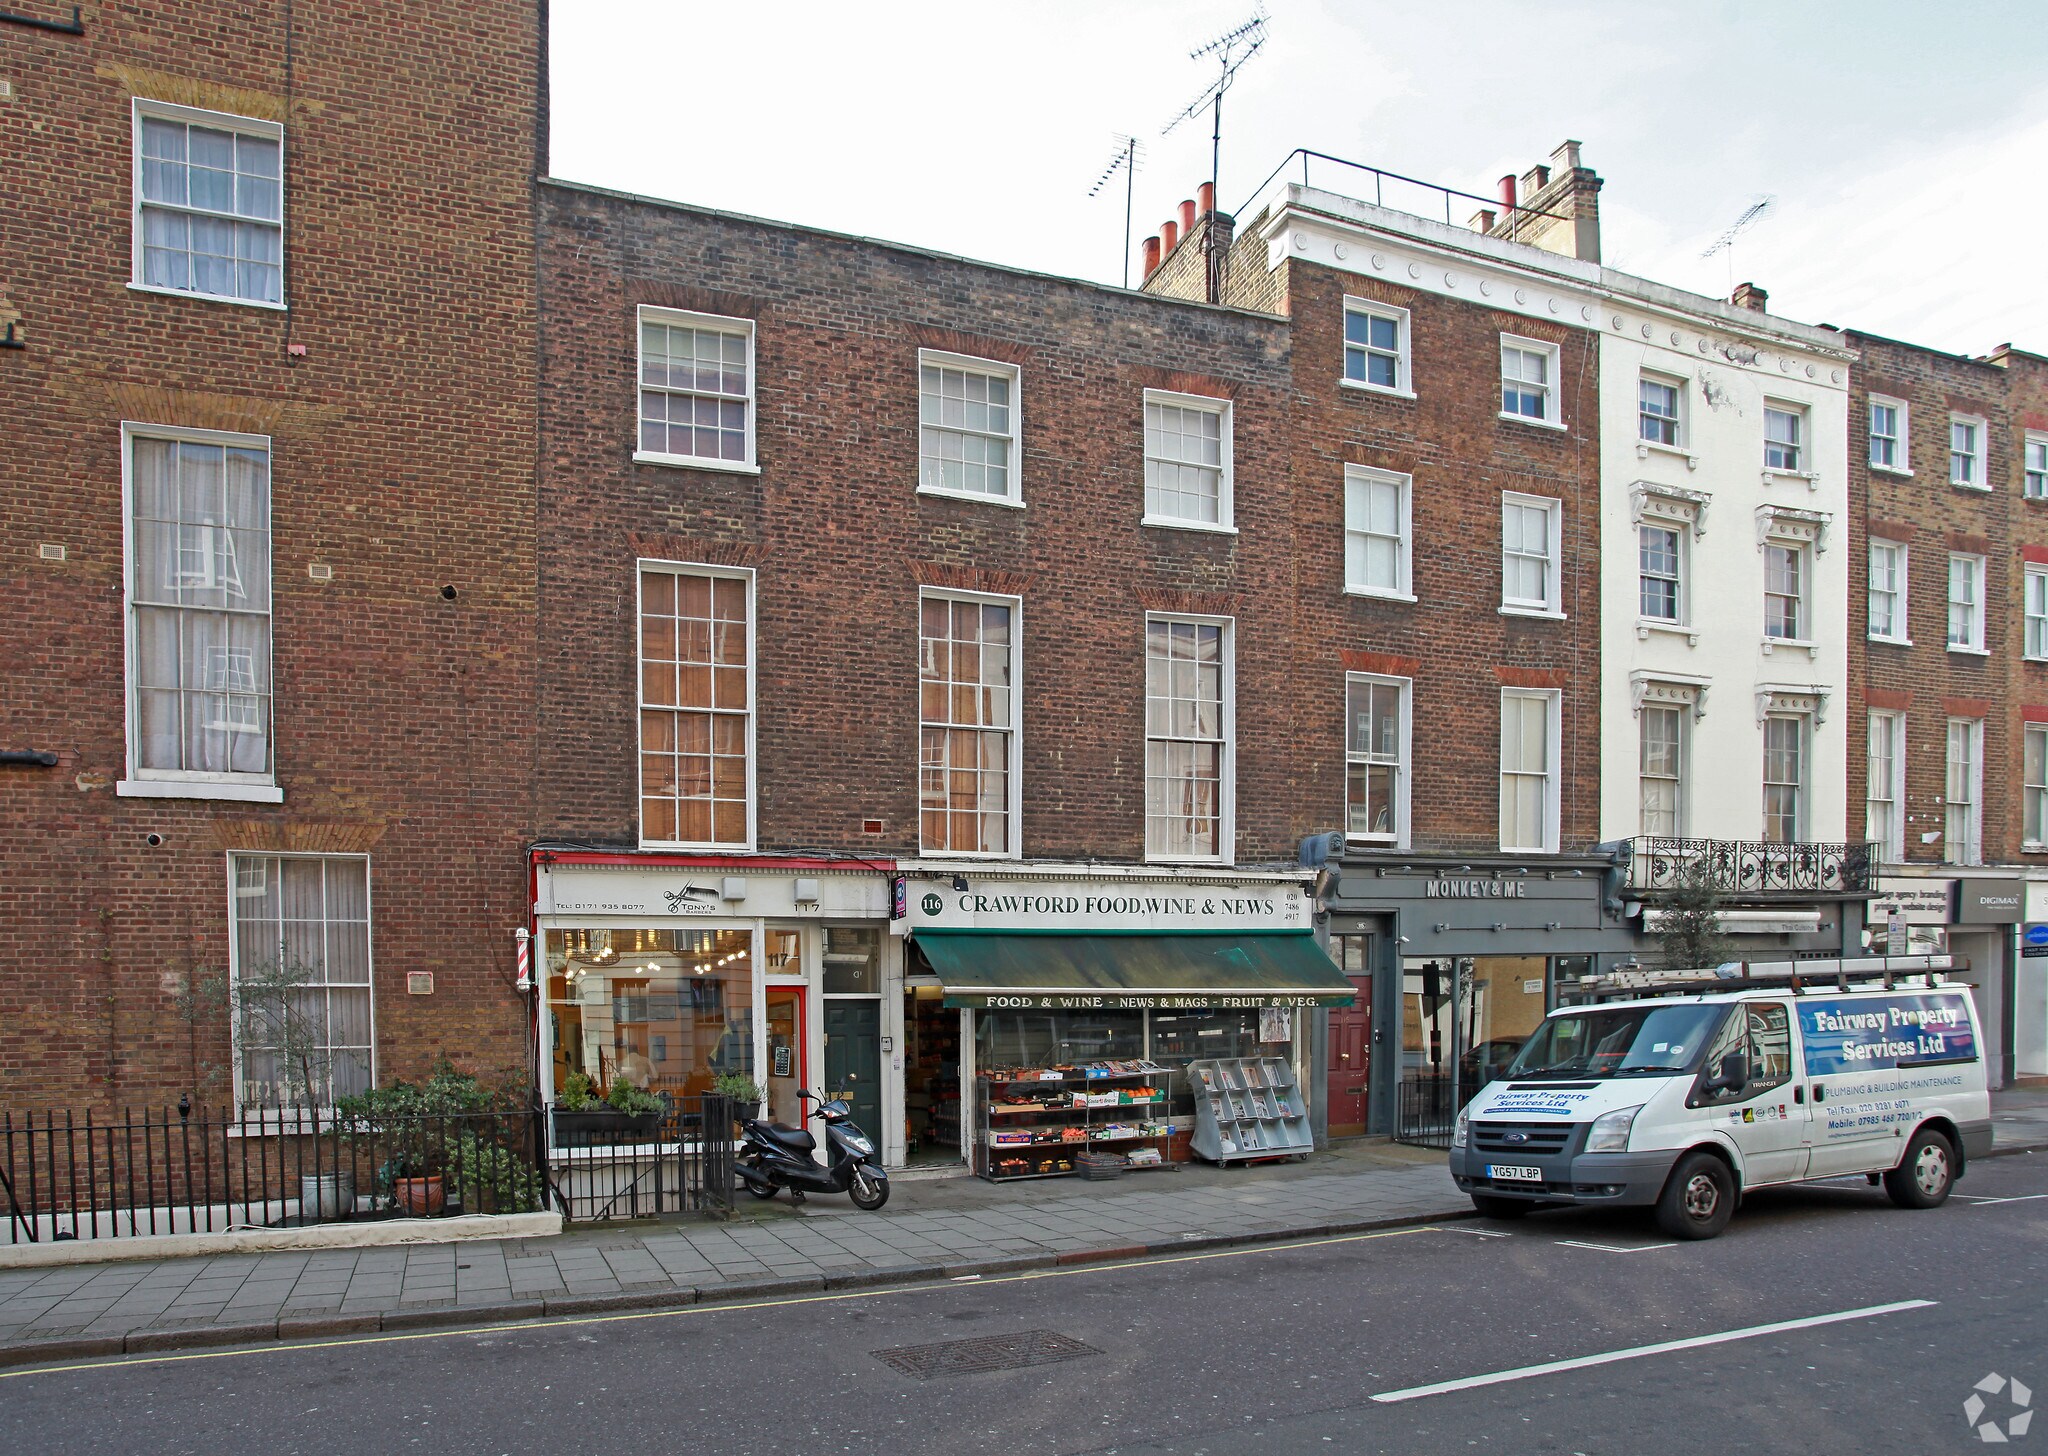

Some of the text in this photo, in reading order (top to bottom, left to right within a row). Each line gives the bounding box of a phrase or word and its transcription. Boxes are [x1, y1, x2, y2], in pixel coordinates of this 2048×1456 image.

[1286, 893, 1298, 901] 020
[1980, 896, 2018, 905] DIGIMAX
[793, 904, 820, 912] 117
[921, 898, 941, 910] 116
[959, 895, 1080, 913] CRAWFORD
[1201, 898, 1216, 915] &
[1221, 899, 1275, 915] NEWS
[1284, 903, 1300, 911] 7486
[768, 953, 788, 967] 117
[986, 996, 1033, 1007] FOOD
[1041, 997, 1052, 1007] &
[1060, 997, 1103, 1007] WINE
[1119, 997, 1154, 1008] NEWS
[1160, 998, 1170, 1007] &
[1174, 998, 1208, 1007] MAGS
[1222, 997, 1265, 1007] FRUIT
[1271, 997, 1280, 1007] &
[1287, 997, 1319, 1007] VEG.
[1814, 1006, 1957, 1033] Fairway Property
[1842, 1033, 1946, 1061] Services Ltd
[1825, 1076, 1962, 1097] PLUMBING & BUILDING MAINTENANCE
[1493, 1091, 1590, 1102] Fairway Property
[1497, 1099, 1544, 1107] Services
[1828, 1120, 1856, 1130] Mobile:
[1493, 1167, 1539, 1179] YG57 LBP
